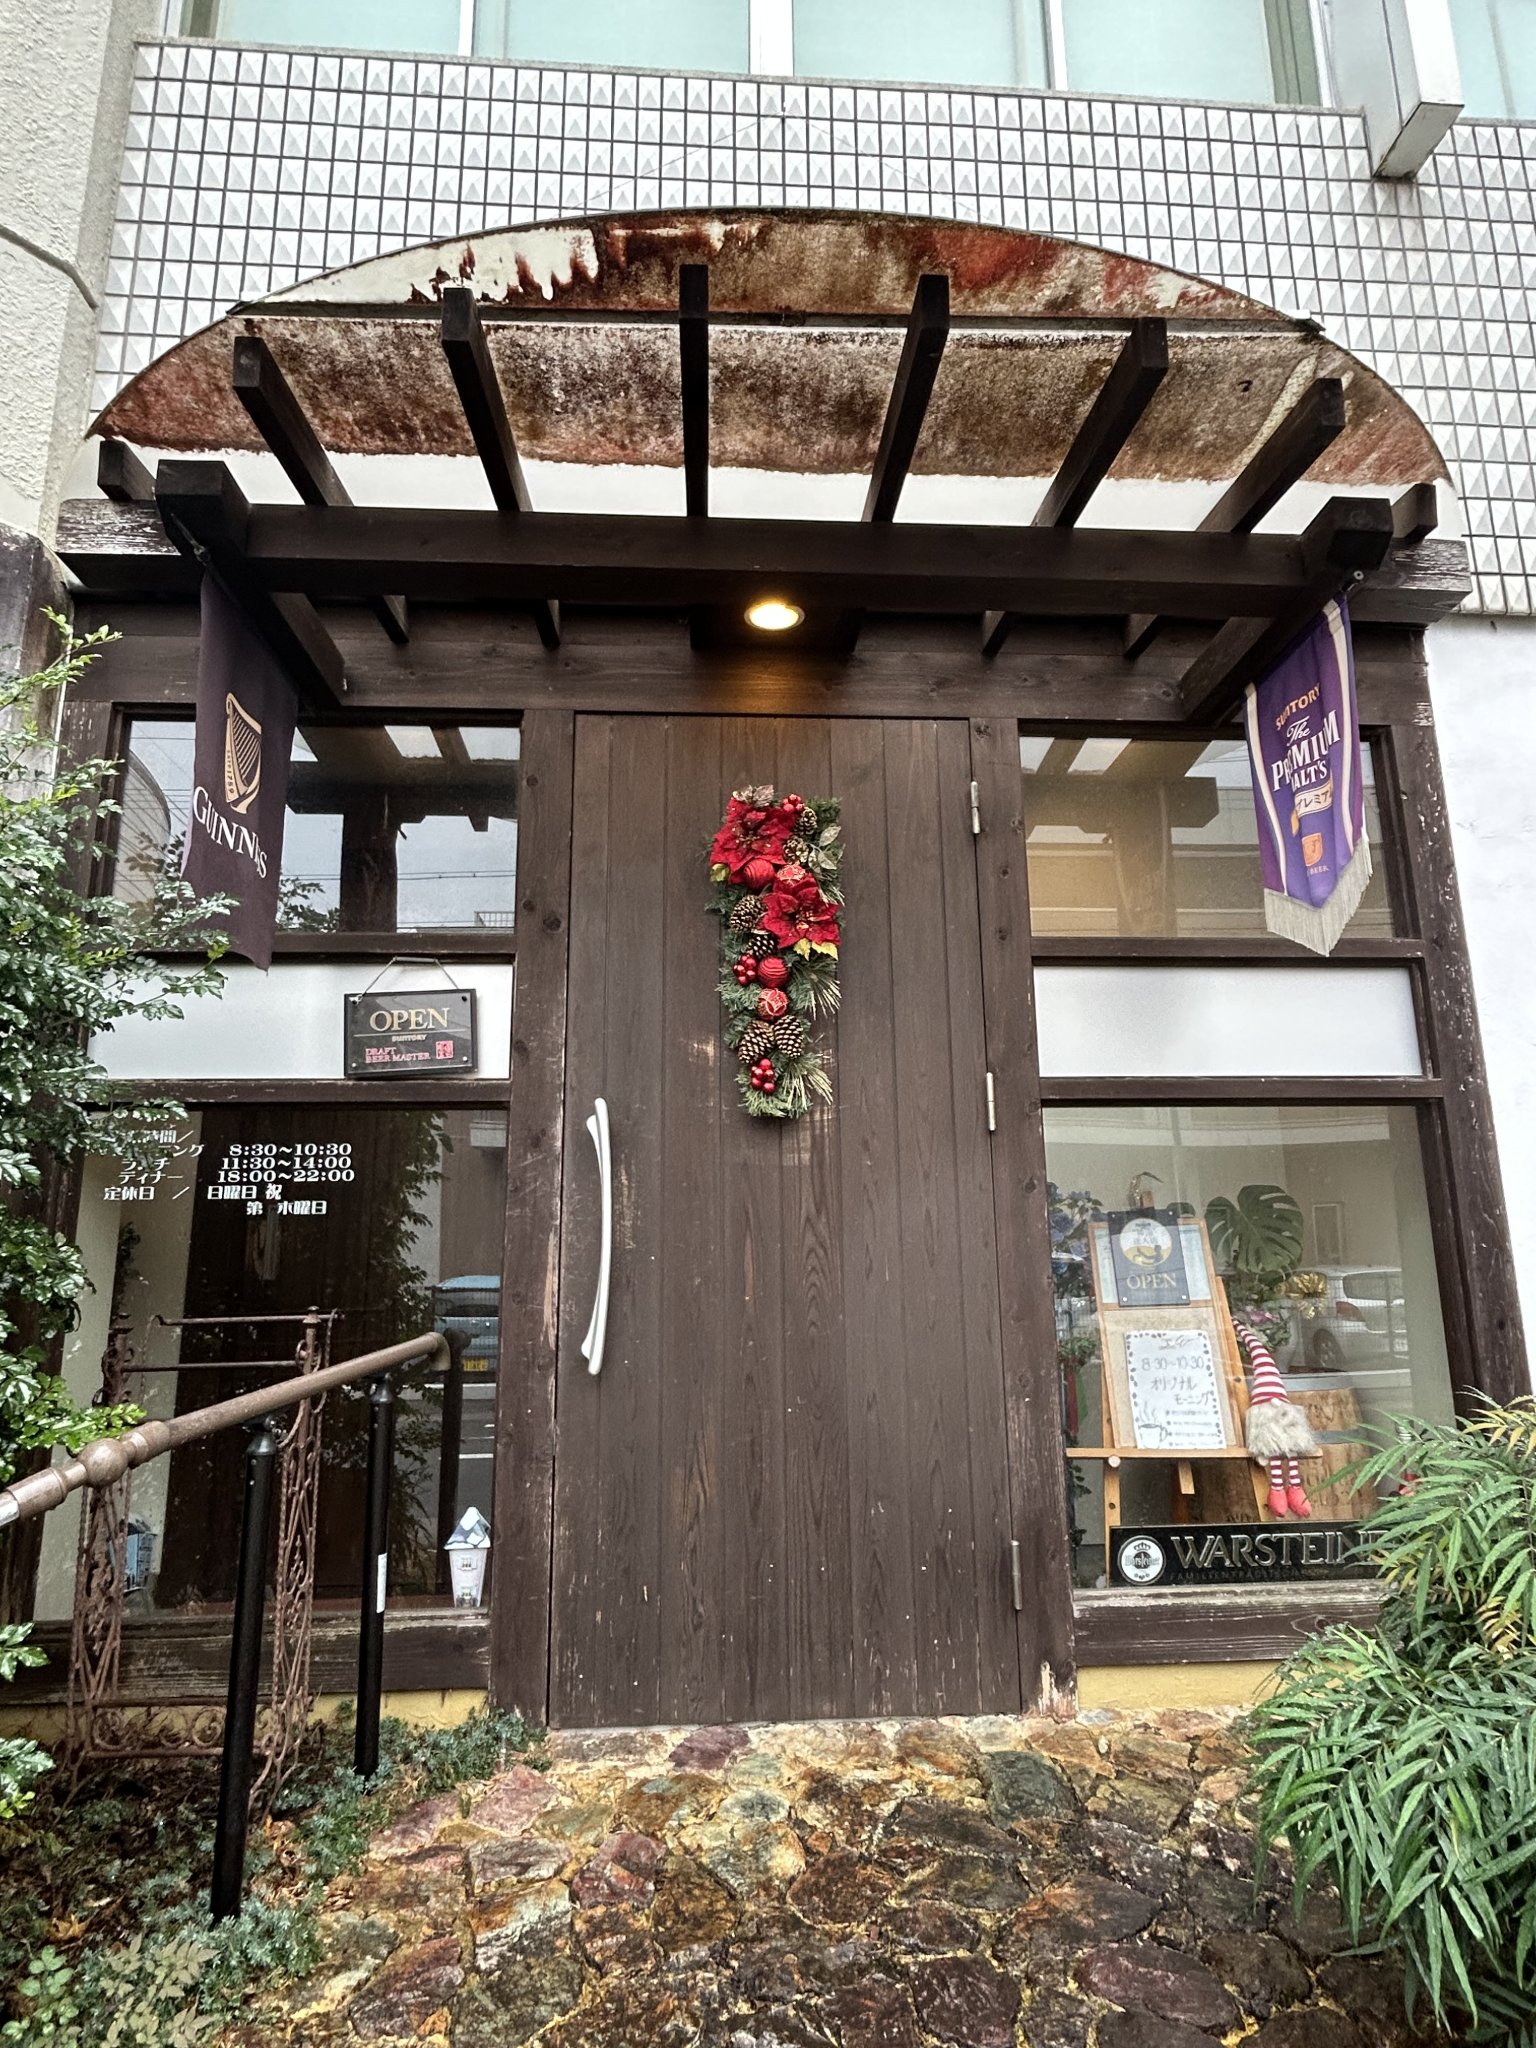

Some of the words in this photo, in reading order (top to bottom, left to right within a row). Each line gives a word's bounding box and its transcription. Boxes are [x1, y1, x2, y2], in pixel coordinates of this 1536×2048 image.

[1286, 716, 1311, 746] The
[1291, 760, 1328, 793] ALT'S
[369, 1007, 450, 1032] OPEN
[365, 1047, 397, 1057] DRAFT
[365, 1055, 391, 1064] BEER
[392, 1052, 431, 1062] MASTER
[121, 1157, 170, 1171] ラチ
[119, 1171, 183, 1184] ディナー
[103, 1186, 155, 1201] 定休日
[207, 1185, 257, 1200] 日曜日
[277, 1200, 327, 1215] 水曜日
[1126, 1272, 1177, 1290] OPEN
